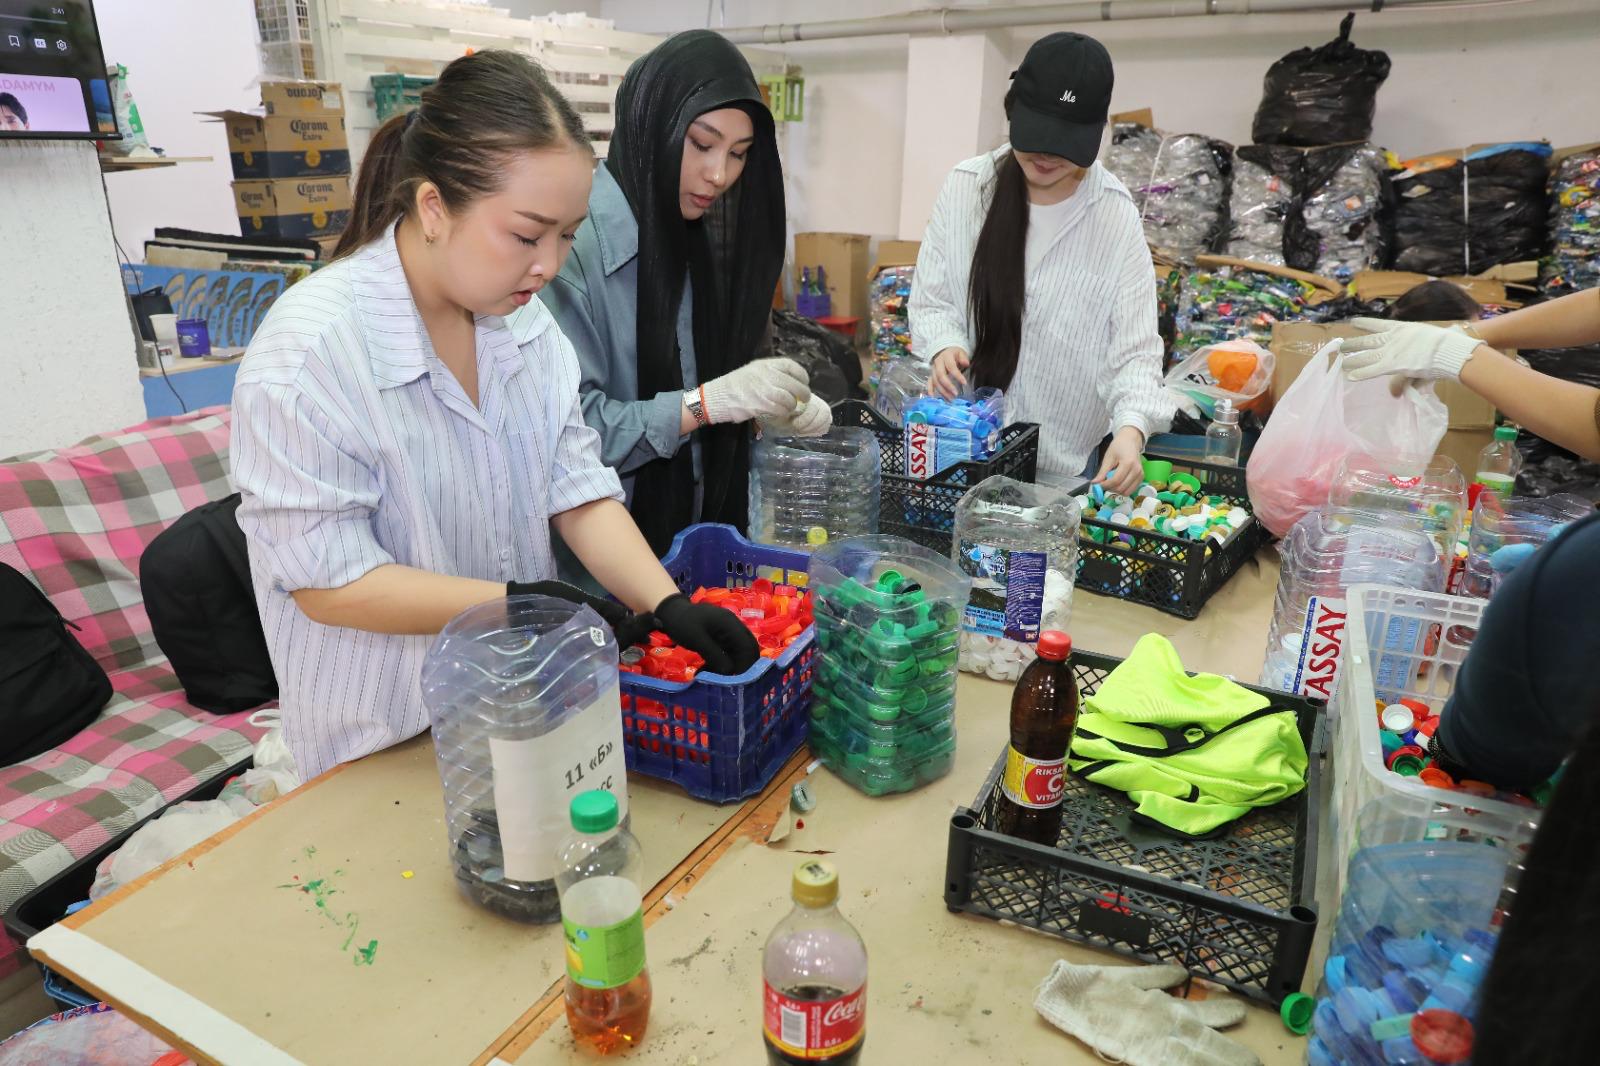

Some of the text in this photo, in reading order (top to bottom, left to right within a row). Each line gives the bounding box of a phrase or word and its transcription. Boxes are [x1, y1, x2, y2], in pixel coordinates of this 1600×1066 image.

[0, 78, 56, 92] DAMYM
[1059, 90, 1076, 103] Me
[290, 119, 329, 134] Corona
[297, 183, 334, 196] Corona
[911, 422, 928, 480] SSAY
[564, 741, 613, 790] 11 «Б»
[1047, 773, 1063, 793] C
